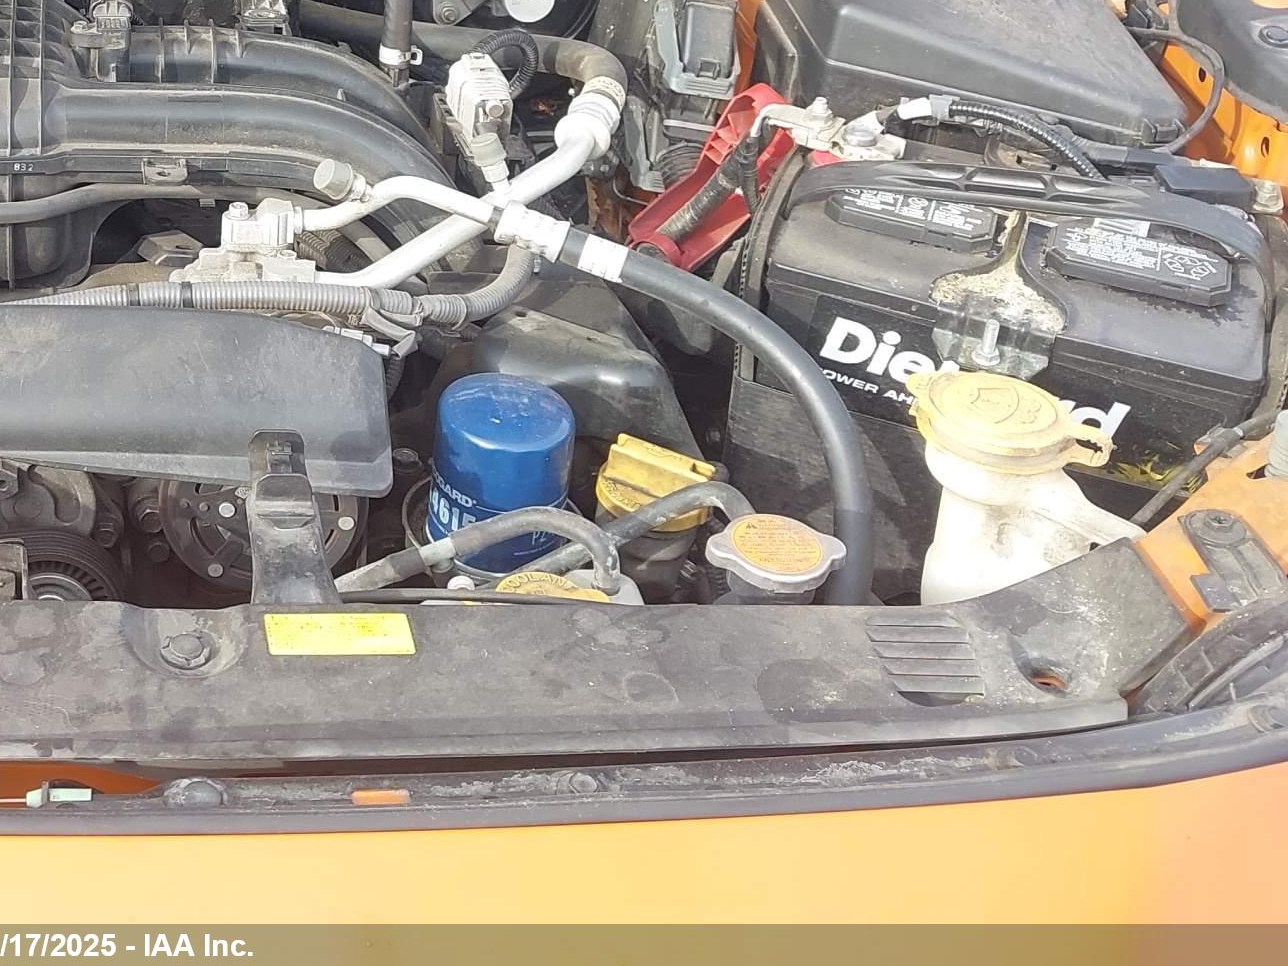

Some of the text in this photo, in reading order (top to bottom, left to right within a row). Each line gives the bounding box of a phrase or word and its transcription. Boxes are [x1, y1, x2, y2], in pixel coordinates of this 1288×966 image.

[13, 162, 34, 172] 832
[819, 316, 1132, 438] Died
[820, 369, 915, 406] OWER AH
